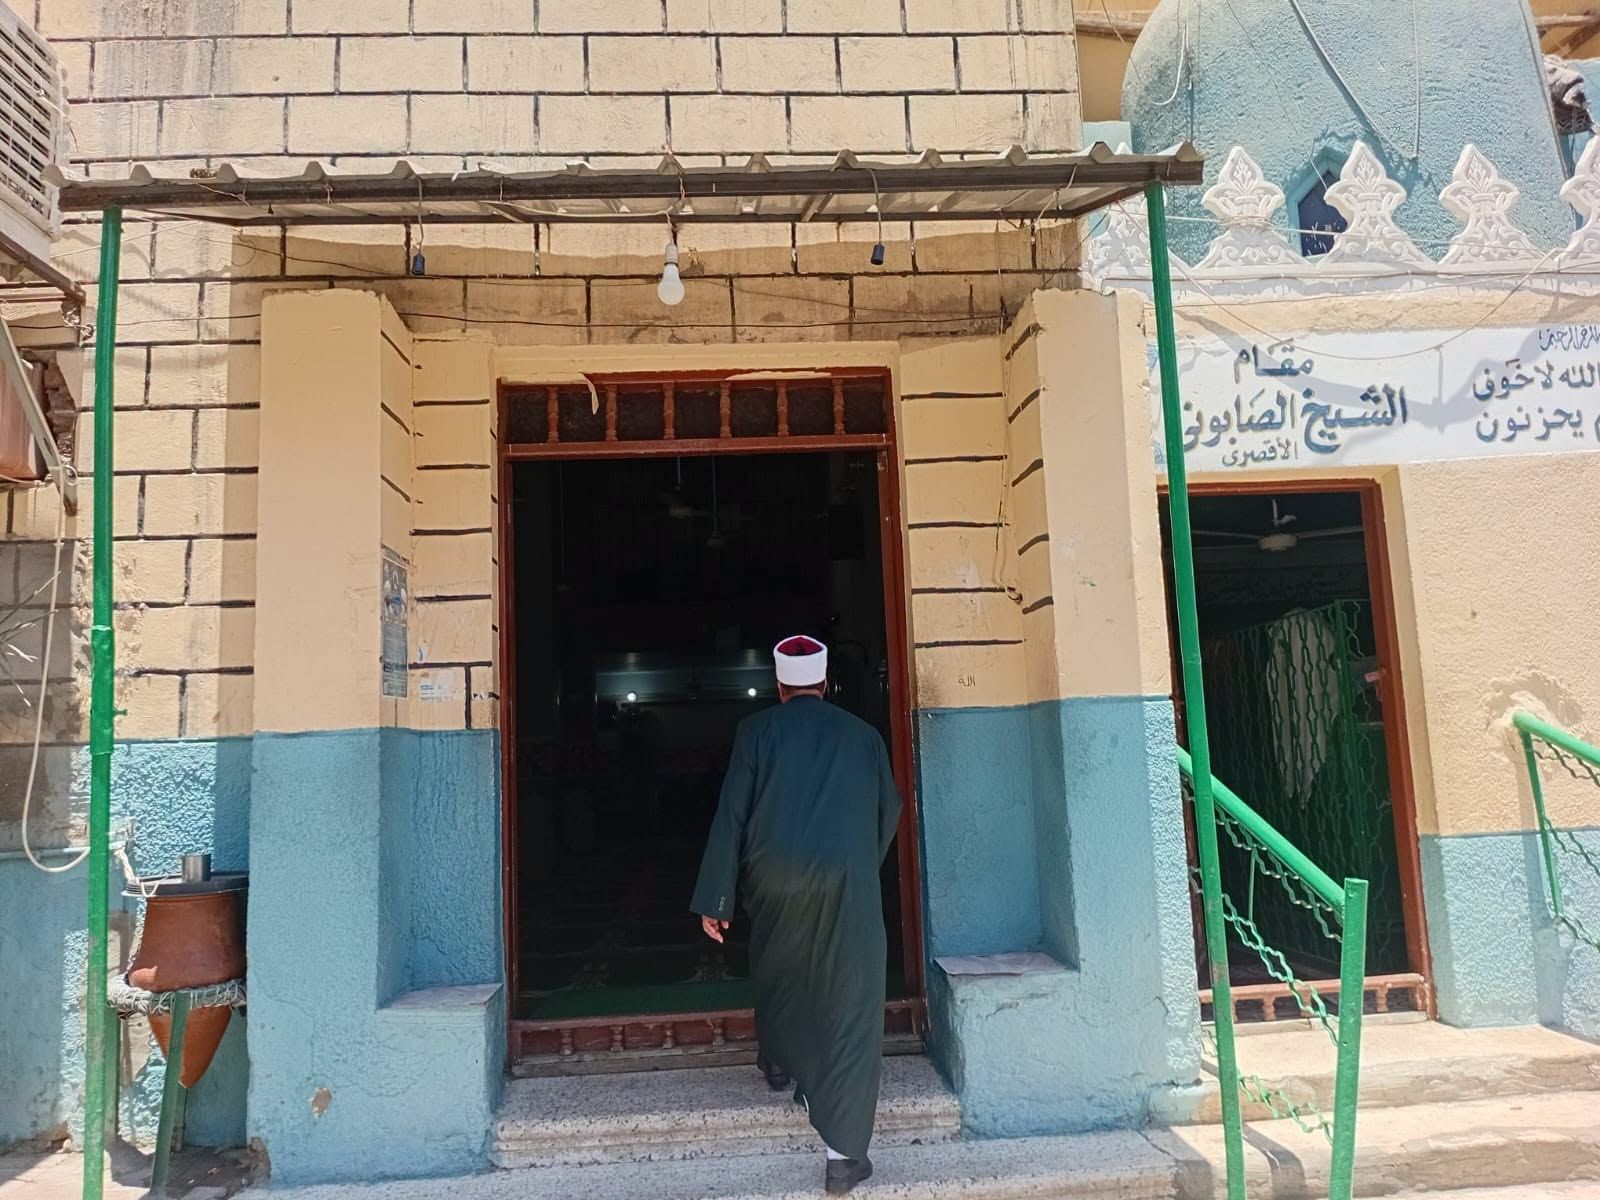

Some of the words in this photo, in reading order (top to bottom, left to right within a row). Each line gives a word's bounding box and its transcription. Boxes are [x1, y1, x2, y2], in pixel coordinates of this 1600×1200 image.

[1533, 360, 1554, 389] لا
[1300, 383, 1408, 454] الشيخ
[1476, 405, 1584, 443] يحزنون
